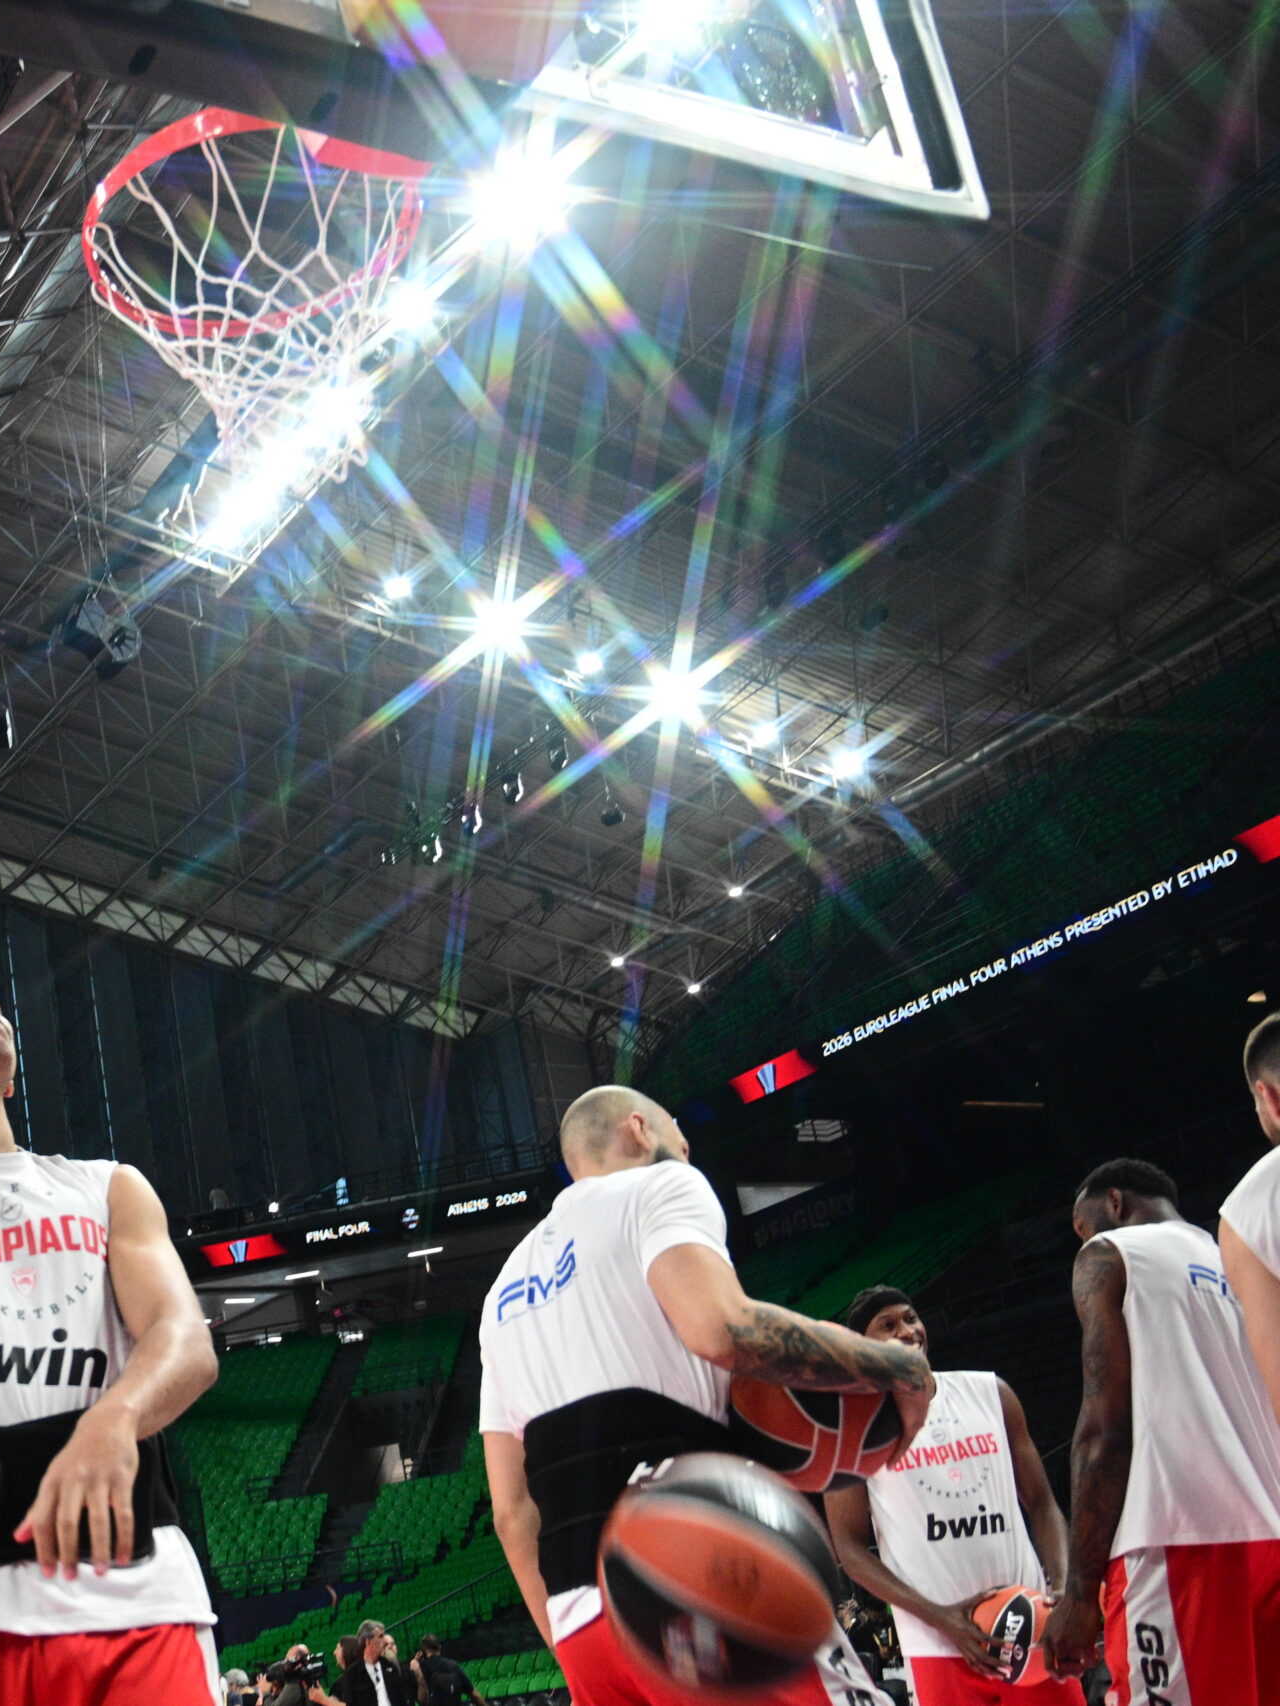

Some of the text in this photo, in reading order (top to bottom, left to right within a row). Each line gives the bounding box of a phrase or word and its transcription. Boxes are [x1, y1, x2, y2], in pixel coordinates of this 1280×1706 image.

[822, 848, 1238, 1057] 2026 EUROLEAGUE FINAL FOUR ATHENS PRESENTED BY ETIHAD
[447, 1191, 528, 1217] ATHENS 2026
[306, 1221, 370, 1244] FINAL FOUR
[926, 1504, 1005, 1541] bwin
